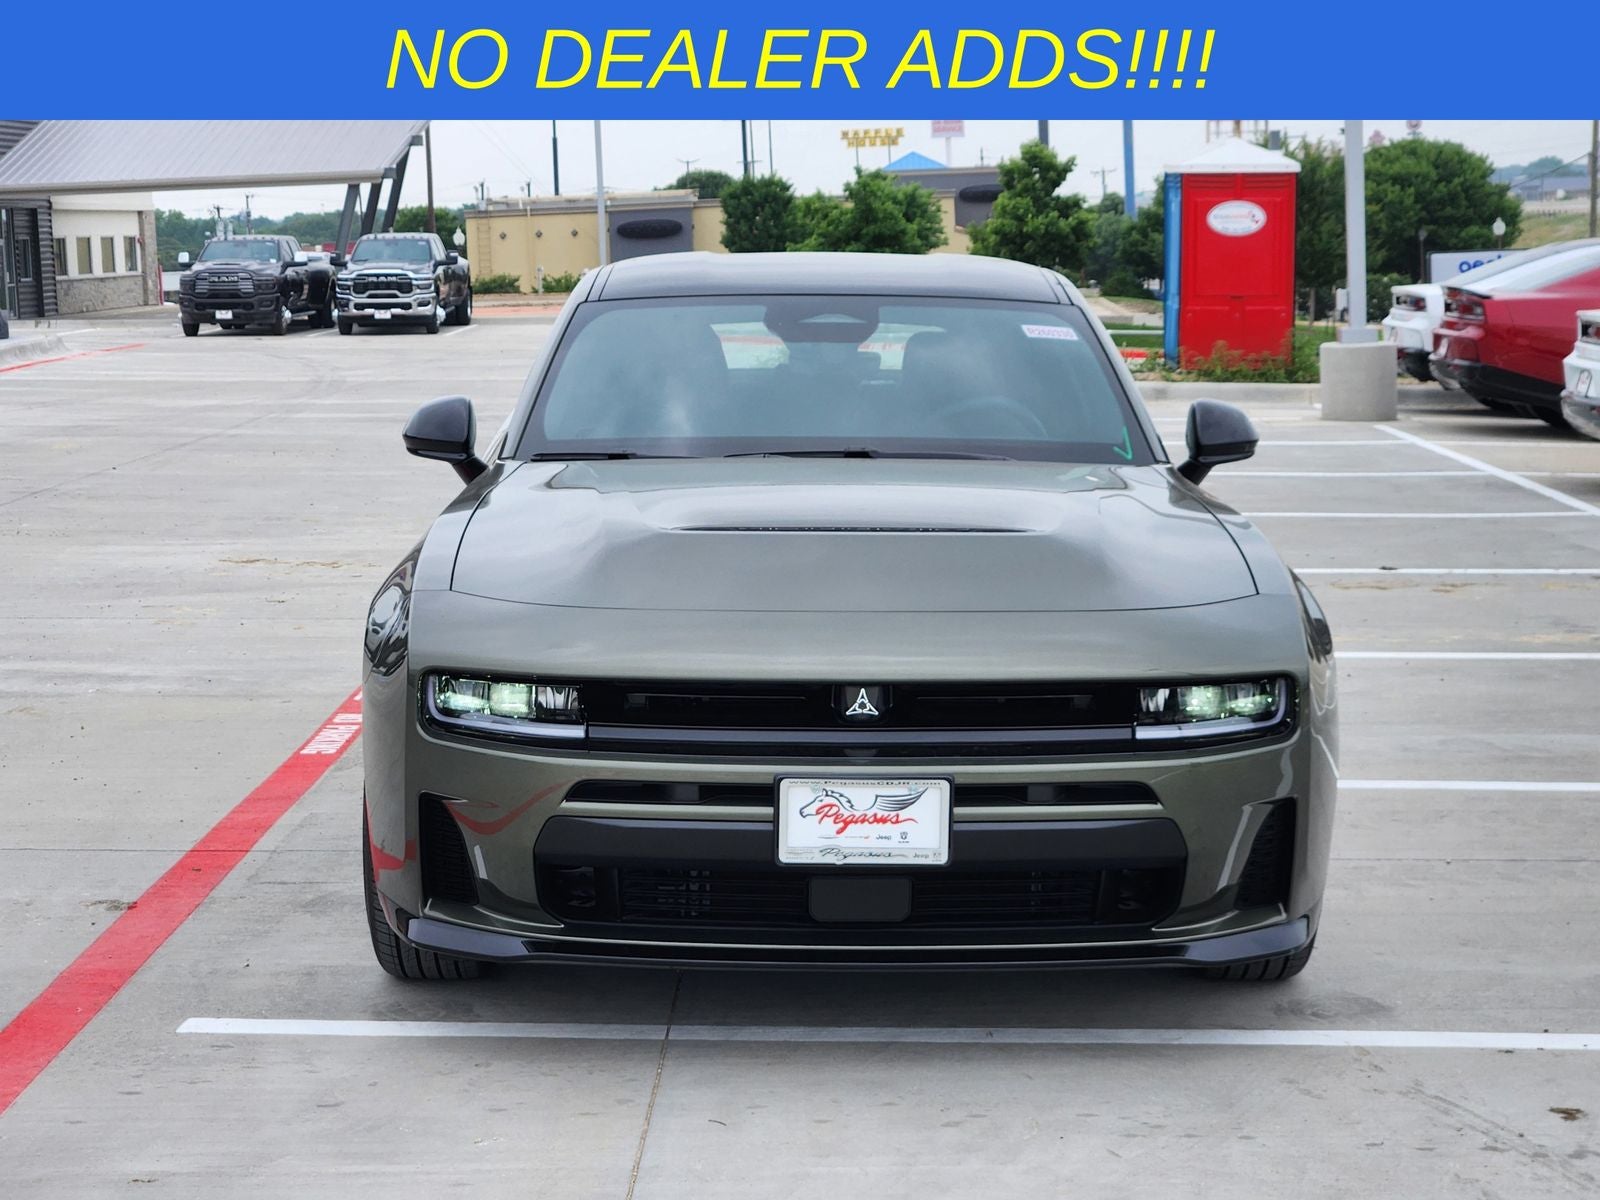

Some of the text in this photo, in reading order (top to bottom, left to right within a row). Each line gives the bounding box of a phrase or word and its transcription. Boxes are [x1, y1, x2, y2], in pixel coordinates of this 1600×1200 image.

[841, 127, 904, 139] WAFFLE
[815, 803, 919, 835] Pegasus
[819, 847, 909, 861] Pegasus
